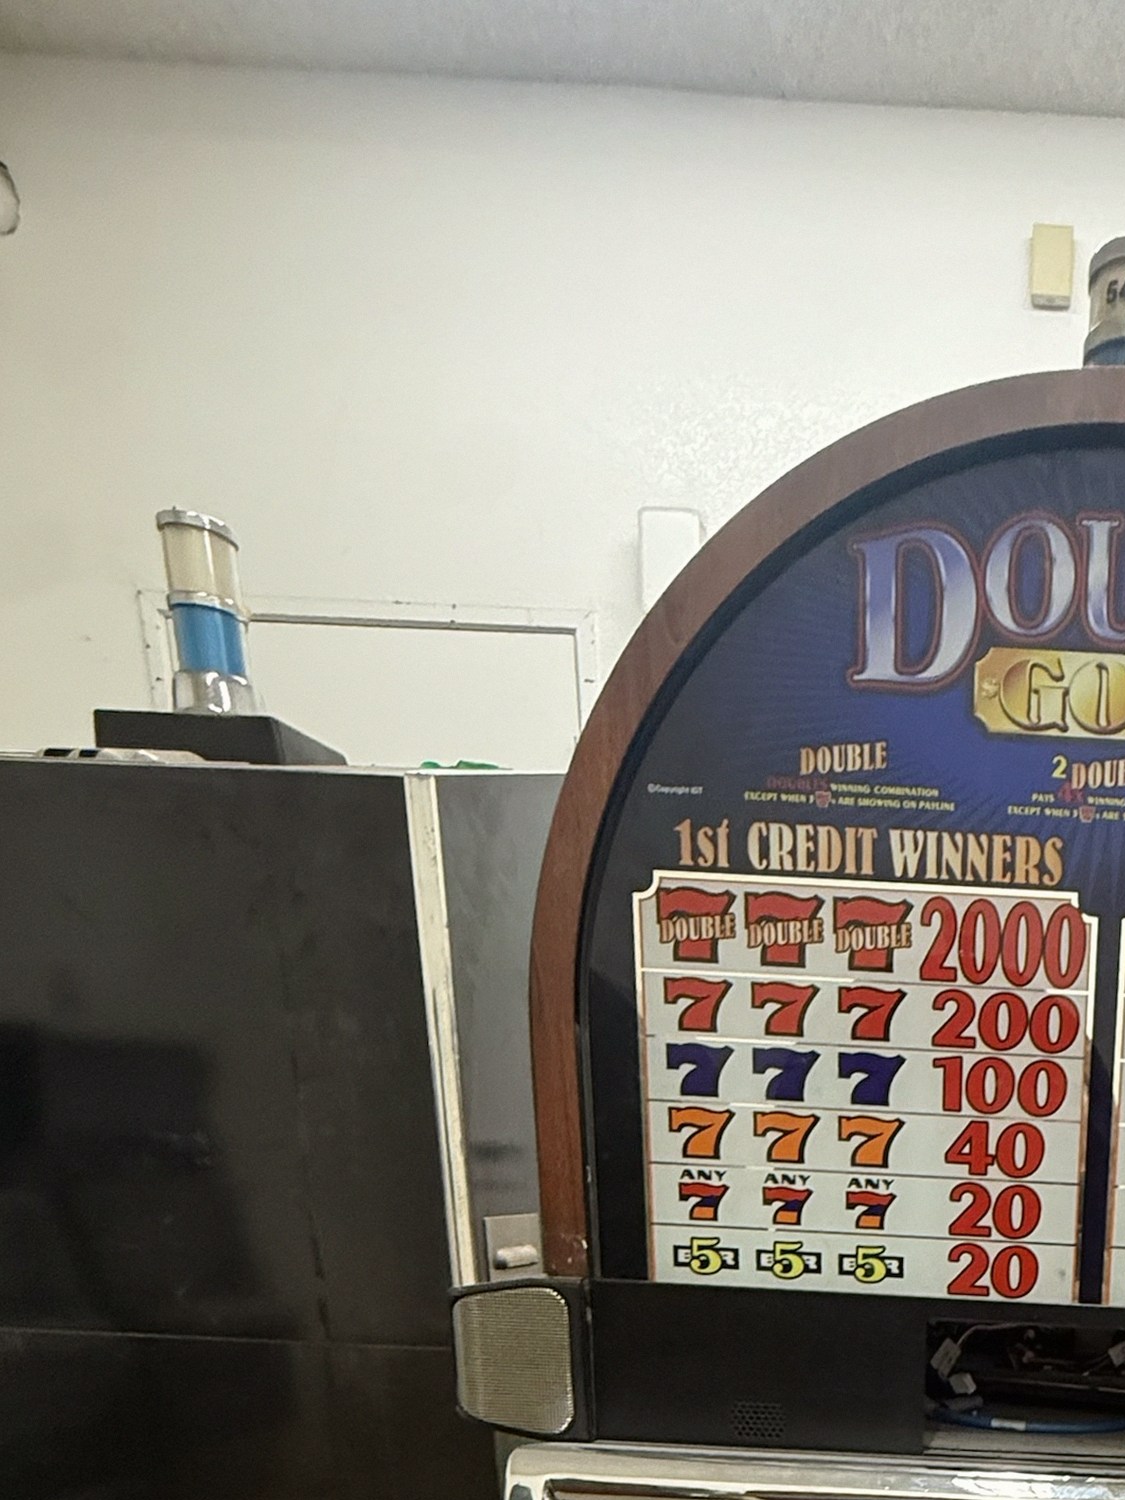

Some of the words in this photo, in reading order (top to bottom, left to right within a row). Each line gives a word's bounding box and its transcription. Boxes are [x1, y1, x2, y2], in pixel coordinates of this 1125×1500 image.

[800, 741, 887, 775] DOUBLE
[1052, 755, 1067, 779] 2
[673, 818, 730, 868] 1st
[747, 821, 878, 876] CREDIT
[889, 828, 1064, 886] WINNERS
[660, 913, 736, 944] DOUBLE
[747, 918, 824, 948] DOUBLE
[835, 922, 912, 953] DOUBLE
[920, 896, 1087, 989] 2000
[932, 989, 1081, 1054] 200
[933, 1056, 1068, 1117] 100
[945, 1121, 1045, 1178] 40
[680, 1168, 727, 1182] ANY
[764, 1173, 811, 1186] ANY
[847, 1177, 895, 1190] ANY
[948, 1182, 1042, 1239] 20
[948, 1243, 1040, 1299] 20
